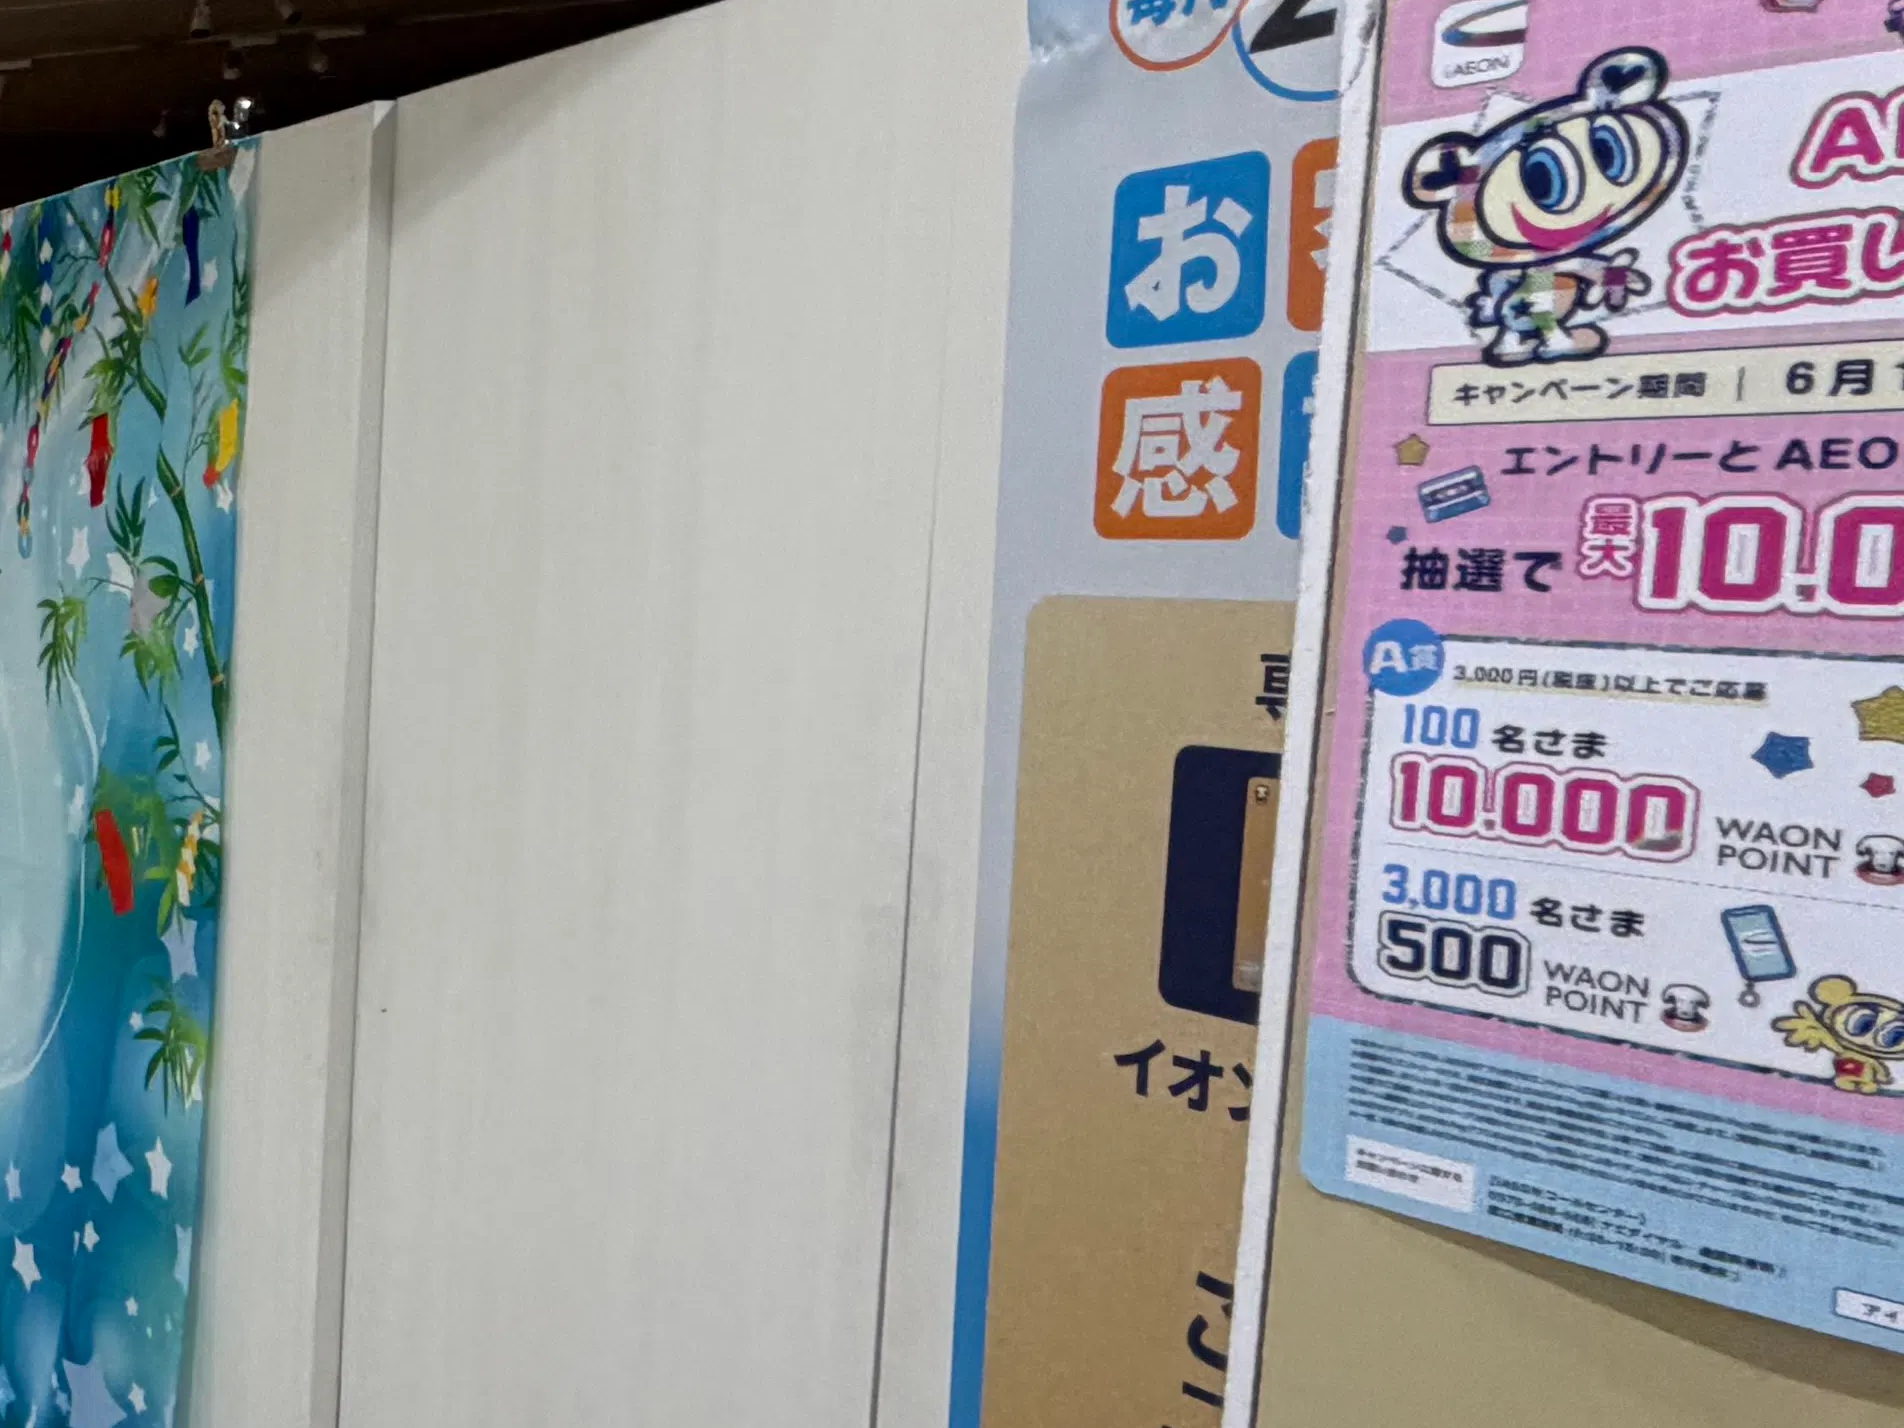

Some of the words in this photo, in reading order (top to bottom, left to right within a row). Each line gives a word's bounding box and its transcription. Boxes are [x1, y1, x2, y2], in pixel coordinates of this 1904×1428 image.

[1802, 100, 1904, 180] A
[1452, 372, 1708, 404] キャンペーン期間
[1785, 358, 1904, 398] 6月
[1399, 546, 1563, 594] 抽選で
[1403, 703, 1481, 749] 100
[1491, 724, 1608, 760] 名さま
[1716, 816, 1843, 851] WAON
[1717, 844, 1841, 877] POINT
[1381, 863, 1518, 921] 3,000
[1530, 896, 1646, 939] 名さま
[1384, 917, 1525, 992] 500
[1544, 958, 1650, 999] WAON
[1545, 984, 1649, 1024] POINT
